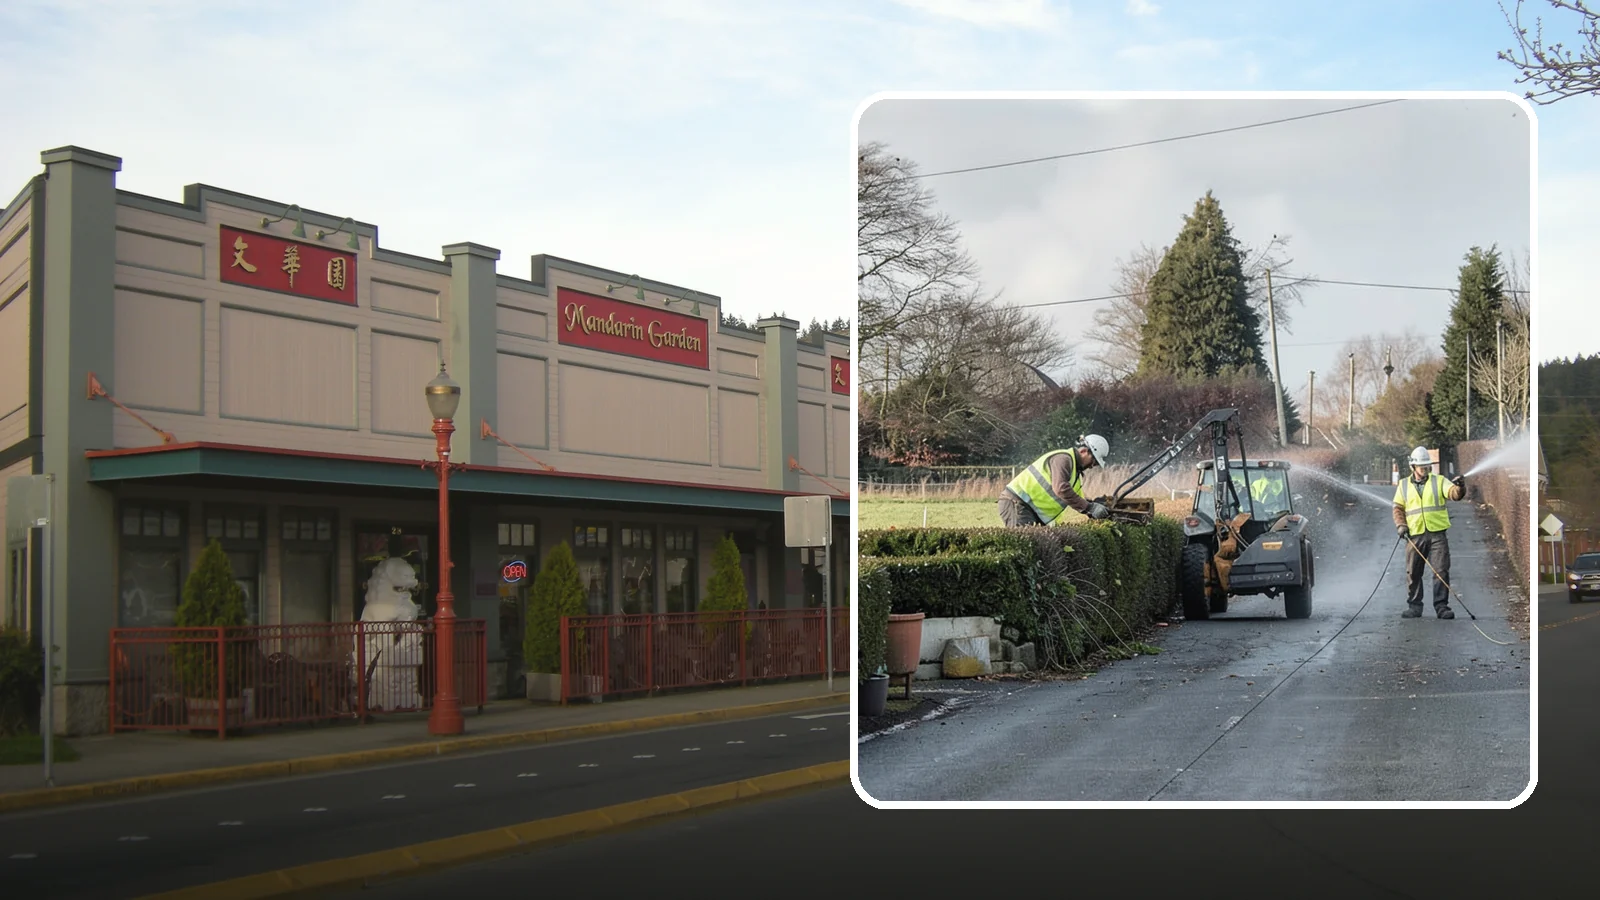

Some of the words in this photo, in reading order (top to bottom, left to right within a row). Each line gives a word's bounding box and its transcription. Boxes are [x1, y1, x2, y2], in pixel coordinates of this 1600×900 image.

[565, 302, 643, 340] Mandarin
[648, 320, 701, 351] Garden
[503, 565, 527, 578] OPEN
